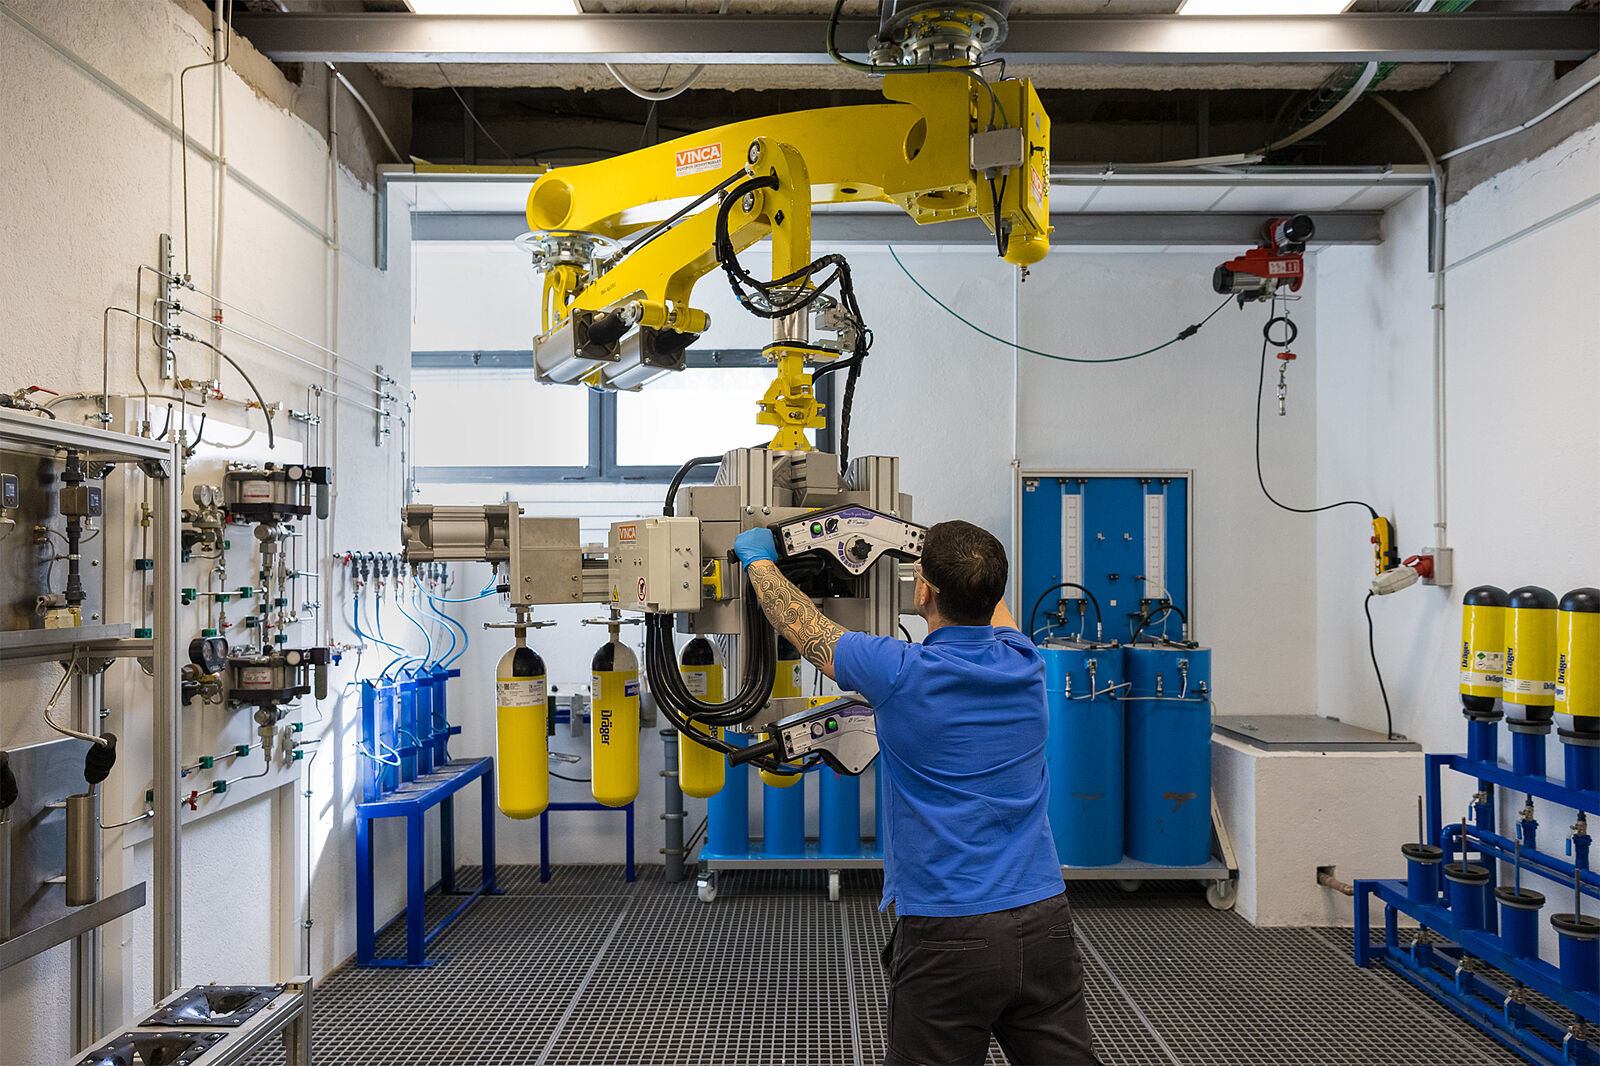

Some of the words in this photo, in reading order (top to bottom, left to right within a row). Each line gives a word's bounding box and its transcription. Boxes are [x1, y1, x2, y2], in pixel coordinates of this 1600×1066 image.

[677, 146, 720, 165] VINCA
[618, 527, 636, 539] VINCA
[1505, 647, 1515, 675] Dräger
[1557, 654, 1567, 684] Dräger
[1485, 675, 1503, 683] Dräge
[600, 710, 612, 746] Dräger
